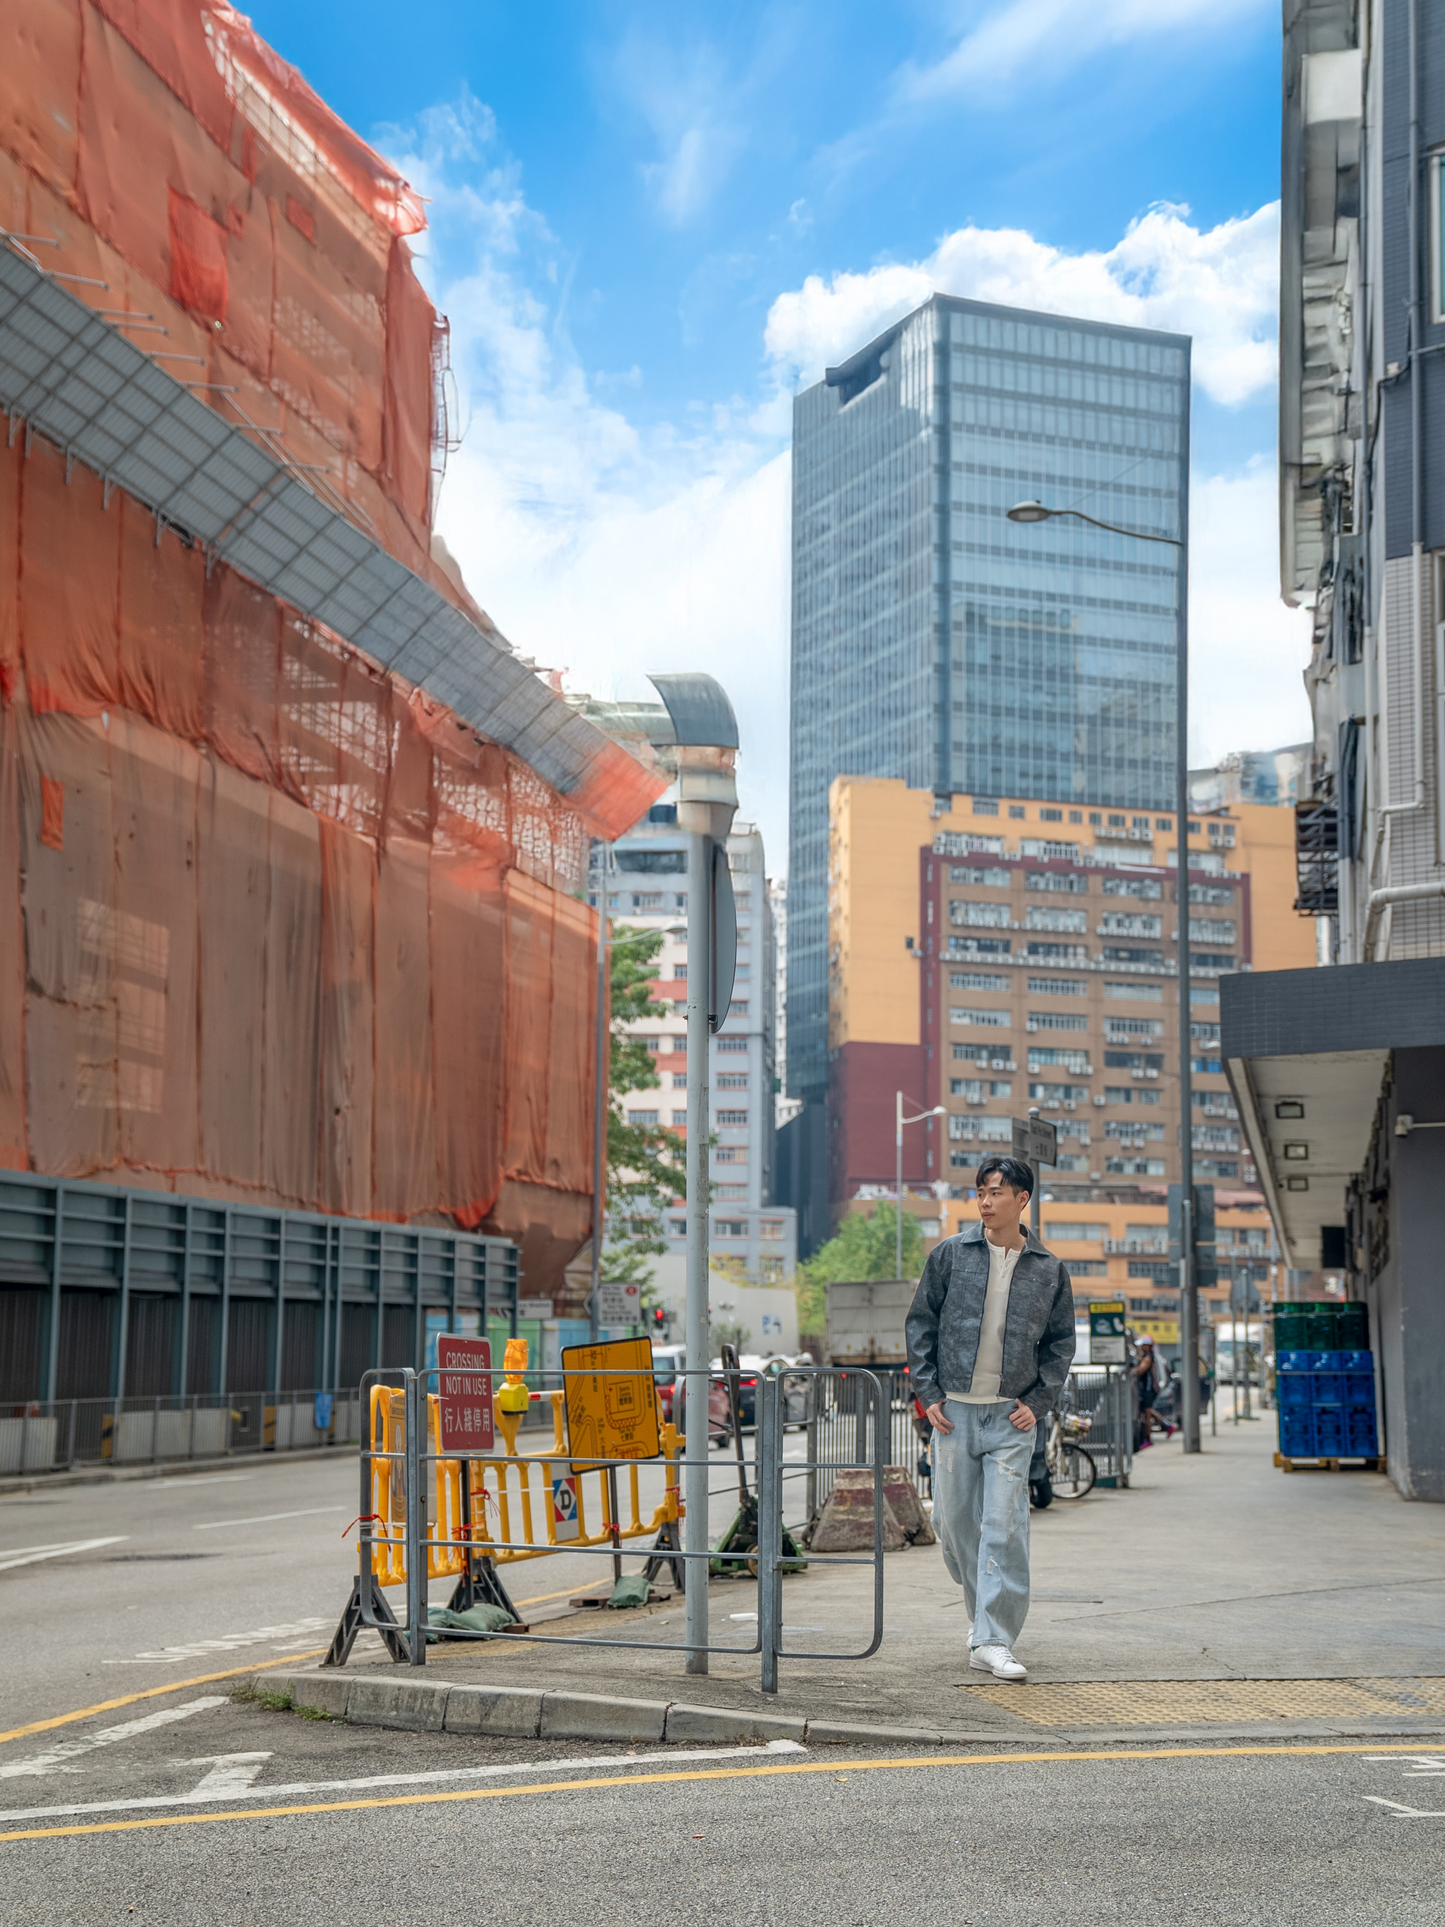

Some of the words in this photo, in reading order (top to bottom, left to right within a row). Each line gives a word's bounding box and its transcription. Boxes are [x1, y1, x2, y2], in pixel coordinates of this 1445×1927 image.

[446, 1352, 485, 1369] CROSSING
[446, 1376, 461, 1395] NOT
[463, 1377, 471, 1395] IN
[472, 1378, 487, 1396] USE
[560, 1489, 571, 1510] D
[101, 1638, 267, 1664] LOOK
